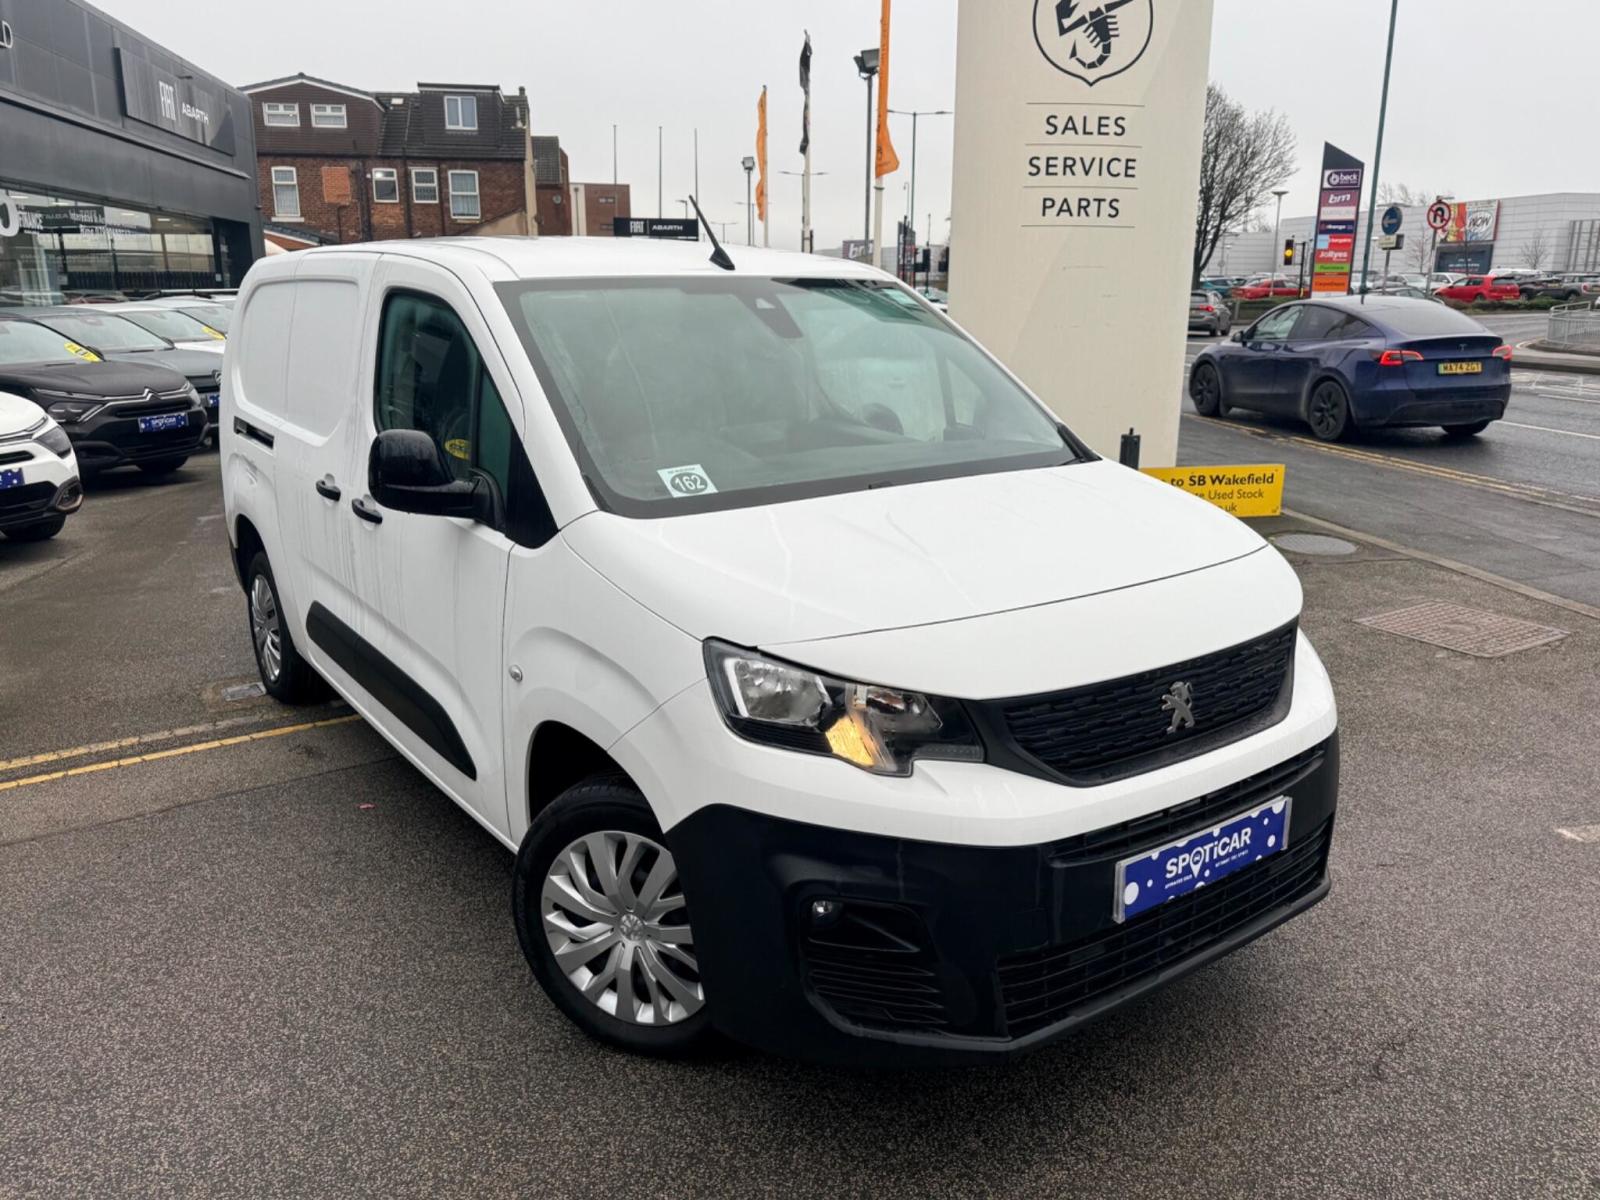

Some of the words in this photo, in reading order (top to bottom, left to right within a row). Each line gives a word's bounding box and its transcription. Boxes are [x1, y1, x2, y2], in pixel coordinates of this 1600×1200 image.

[159, 80, 176, 120] FIAT
[182, 102, 209, 126] ABARTH
[1045, 114, 1126, 136] SALES
[1028, 156, 1137, 178] SERVICE
[1042, 197, 1120, 218] PARTS
[630, 220, 645, 233] FIAT
[652, 223, 684, 231] ABARTH
[674, 474, 705, 492] 162
[1170, 477, 1185, 487] to
[1189, 474, 1207, 487] SB
[1209, 472, 1275, 486] Wakefield
[1207, 489, 1234, 500] Used
[1236, 488, 1264, 499] Stock
